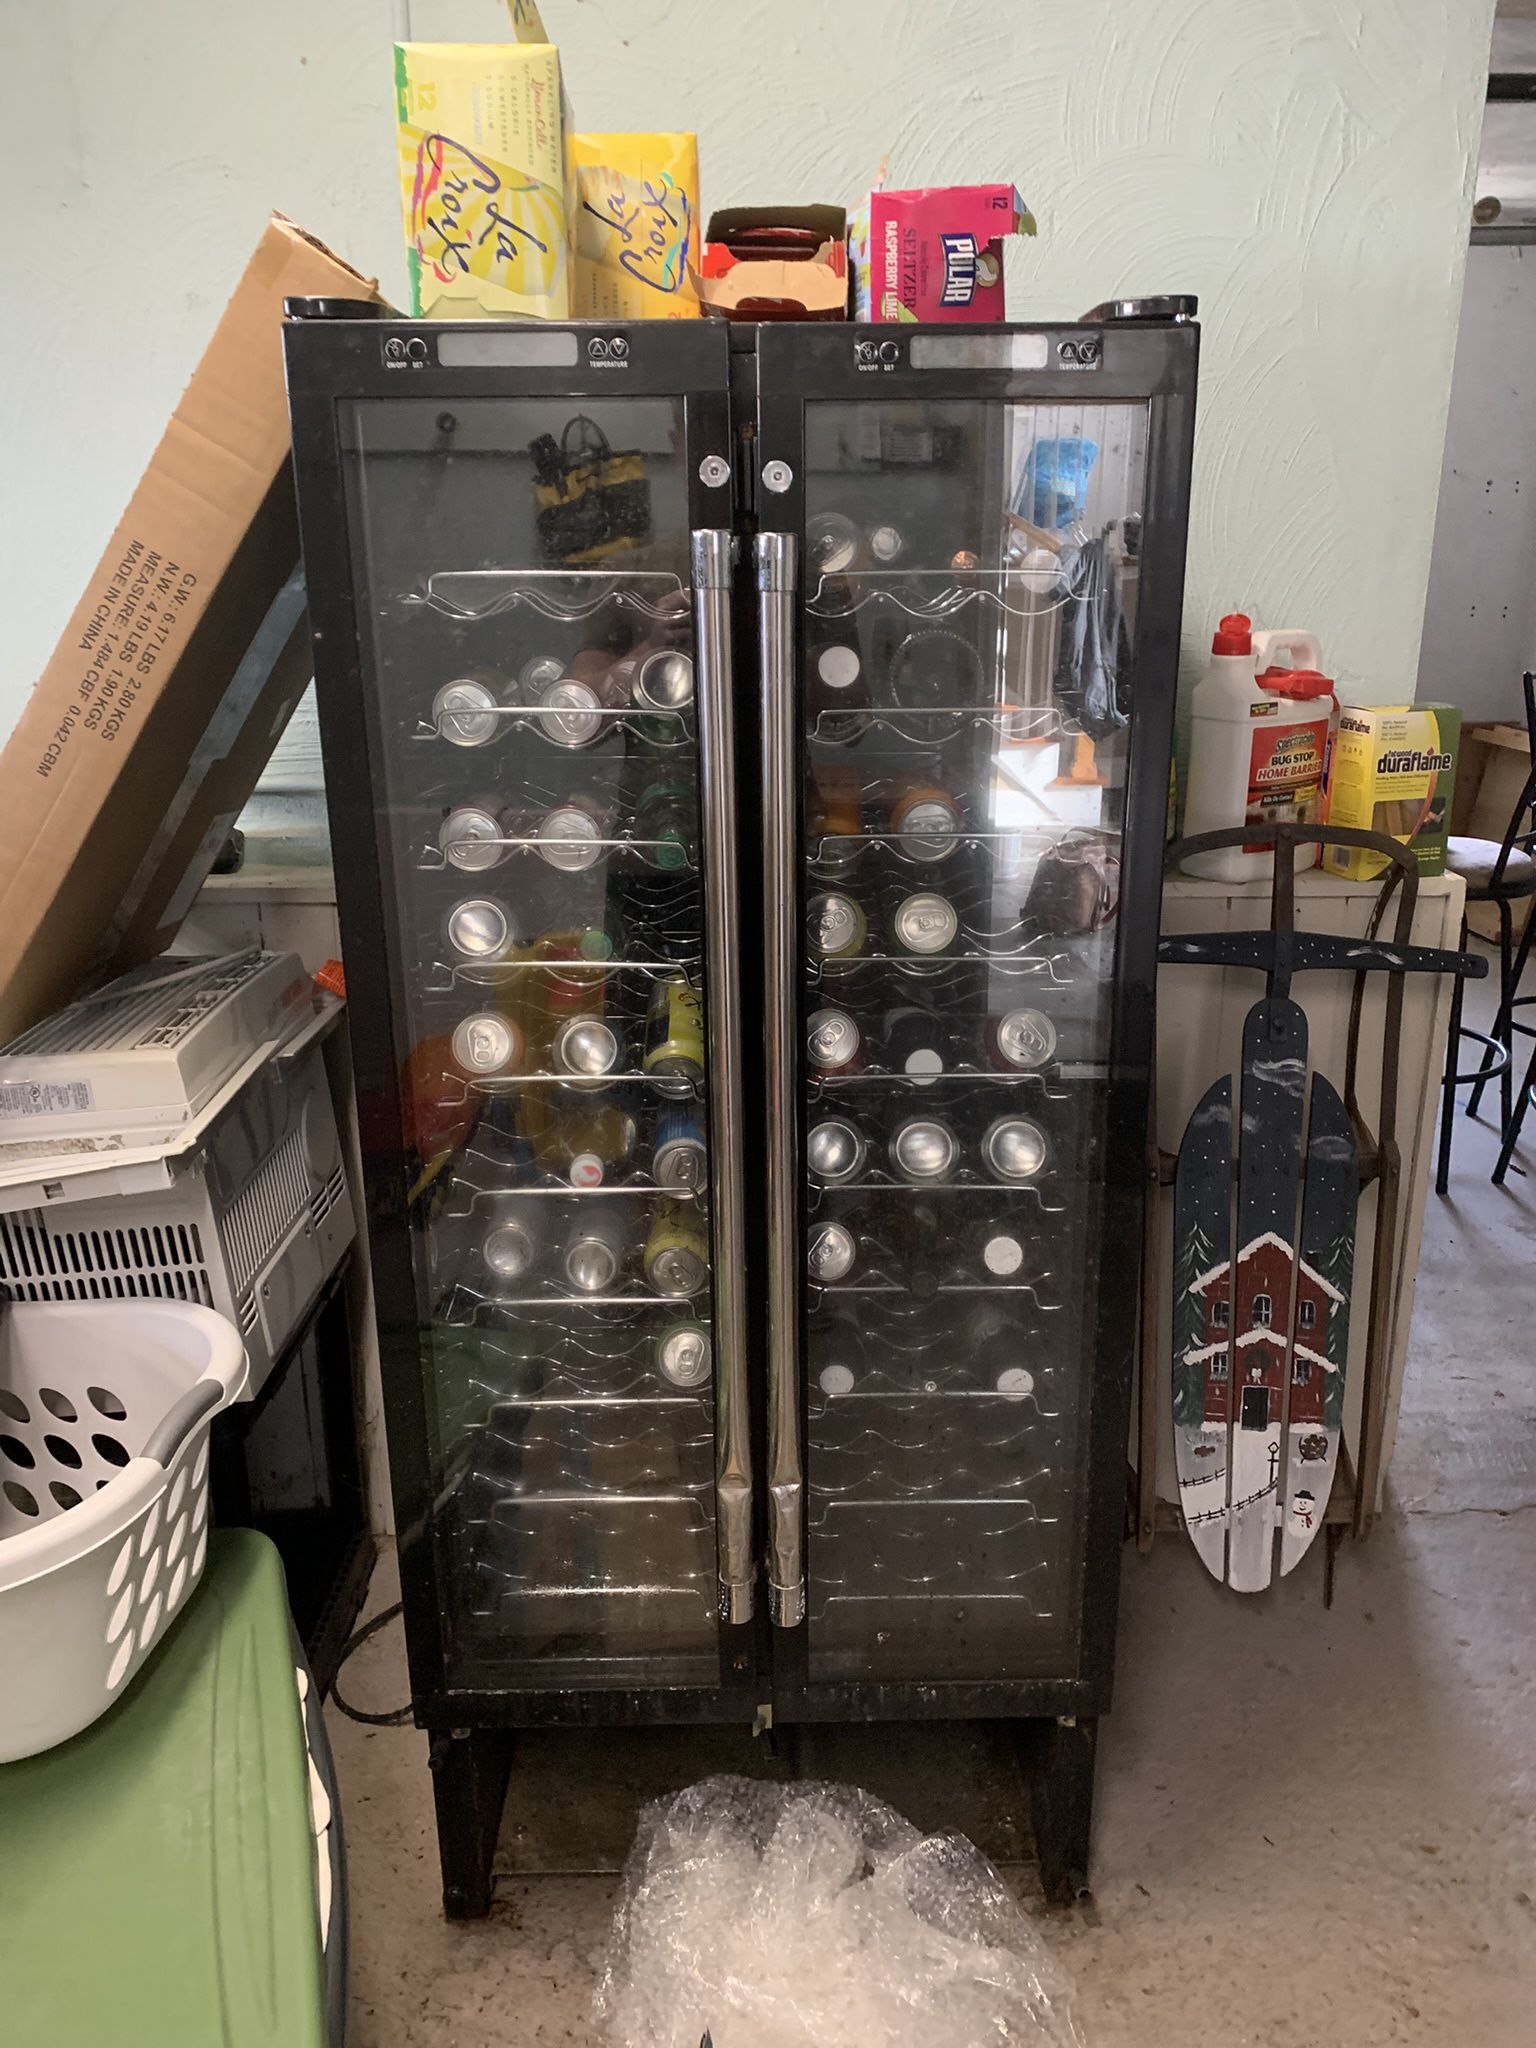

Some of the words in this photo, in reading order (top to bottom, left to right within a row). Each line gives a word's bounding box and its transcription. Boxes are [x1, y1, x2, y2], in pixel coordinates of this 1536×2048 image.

[417, 81, 437, 112] 12
[426, 133, 502, 275] Croix
[582, 191, 639, 243] La
[992, 196, 1008, 209] 12
[478, 201, 548, 264] La
[619, 178, 678, 293] Croix
[884, 221, 898, 289] RASPBERRY
[903, 228, 917, 309] SELTZER
[885, 291, 898, 321] LIME
[589, 360, 628, 369] TEMPERATURE
[1058, 363, 1097, 372] TEMPERATURE
[113, 540, 145, 585] MADE
[104, 587, 119, 605] IN
[112, 551, 162, 629] MEASURE:
[79, 604, 111, 650] CHINA
[139, 602, 159, 634] 4.19
[157, 611, 177, 645] 6.17
[97, 633, 119, 671] 1.484
[119, 634, 141, 664] LBS
[137, 643, 161, 675] LBS
[79, 672, 100, 702] CBF
[105, 667, 123, 696] 1.90
[122, 677, 142, 709] 2.80
[60, 704, 81, 742] 0.042
[83, 694, 107, 731] KGS
[101, 709, 126, 742] KGS
[36, 743, 62, 777] CBM
[1257, 767, 1289, 780] HOME
[1271, 755, 1292, 766] BUG
[1293, 751, 1315, 763] STOP
[1377, 752, 1451, 773] duraflame
